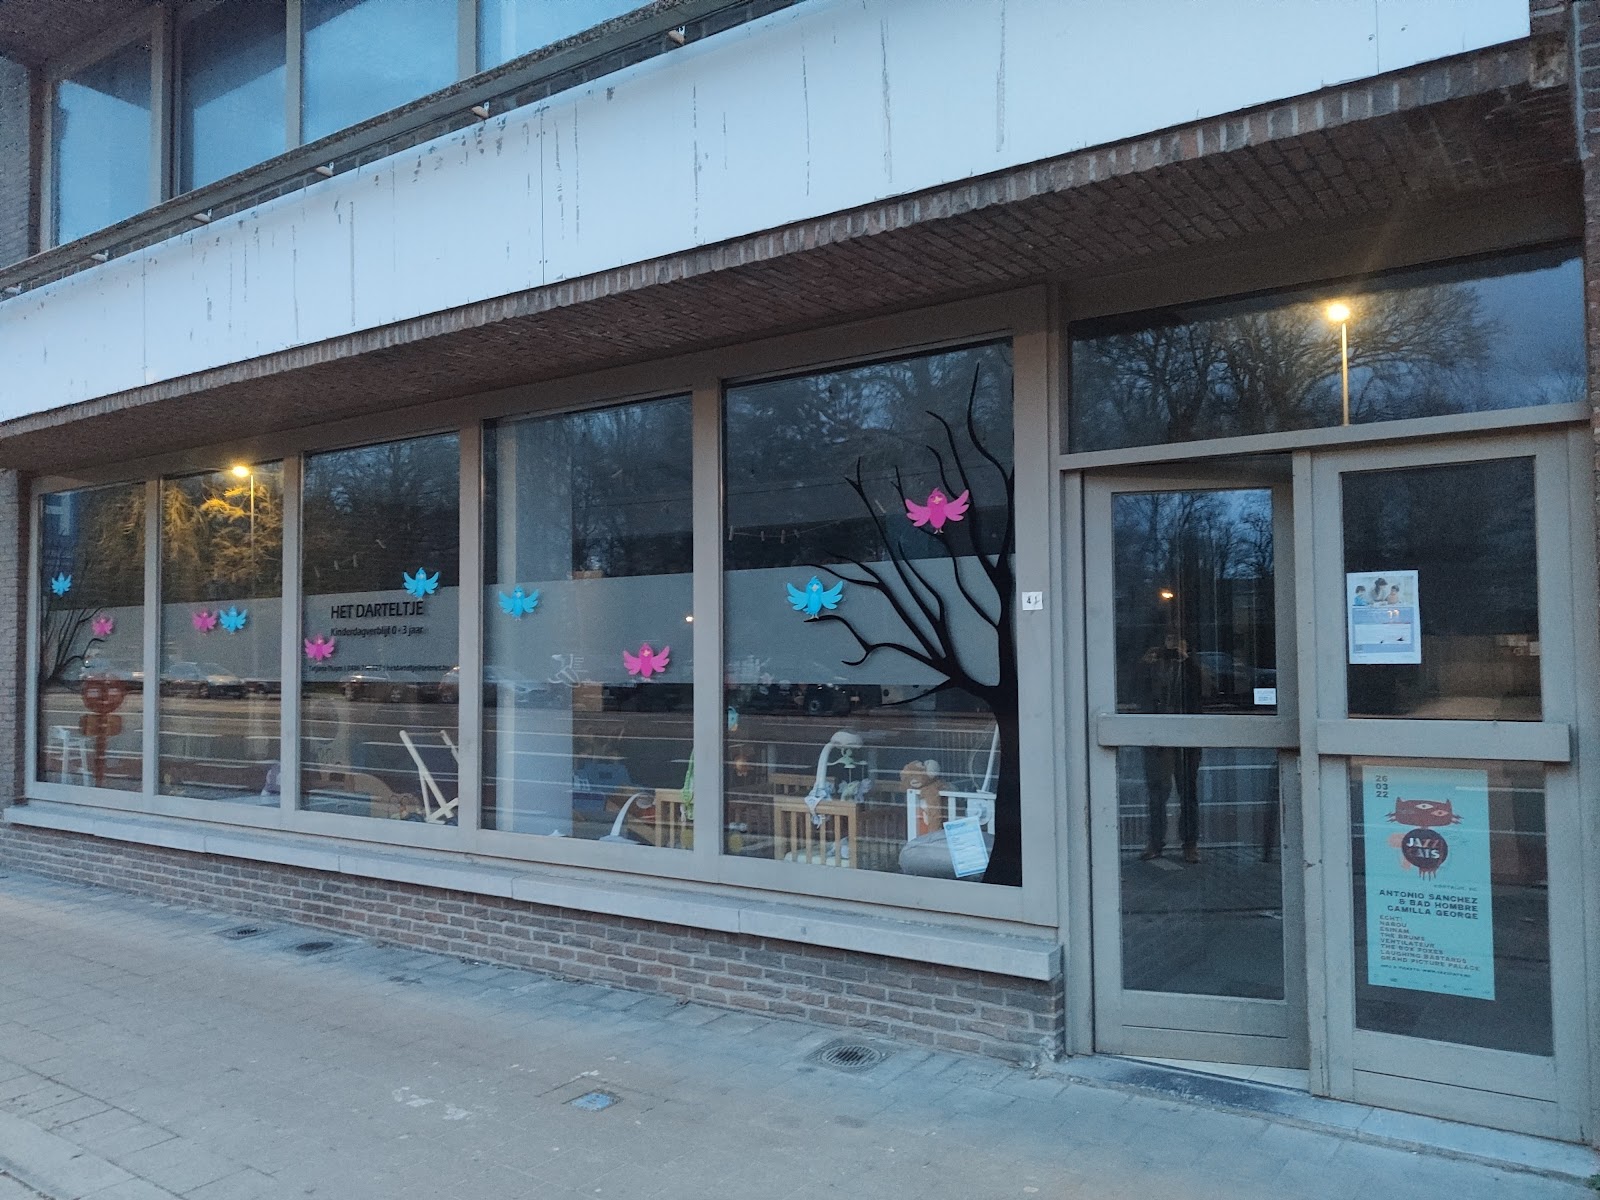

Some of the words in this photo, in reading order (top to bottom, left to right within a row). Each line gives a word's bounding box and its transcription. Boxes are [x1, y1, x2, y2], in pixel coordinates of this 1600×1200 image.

[331, 605, 354, 619] HET
[356, 601, 424, 618] DARTELTJE
[331, 626, 390, 638] Kinderdagverblijf
[392, 625, 397, 635] 0
[401, 625, 407, 635] 3
[1406, 837, 1440, 849] JAZZ
[1379, 889, 1425, 899] ANTONIO
[1428, 893, 1478, 904] SANCHEZ
[1387, 905, 1431, 915] CAMILLA
[1435, 910, 1479, 920] GEORGE
[1409, 899, 1431, 907] BAD
[1435, 902, 1479, 912] HOMBRE
[1380, 938, 1435, 948] VENTILATEUR
[1380, 949, 1421, 958] LAUGHING
[1423, 953, 1467, 964] BASTARDS
[1380, 955, 1407, 963] GRAND
[1411, 957, 1445, 967] PICTURE
[1447, 963, 1480, 971] PALACE
